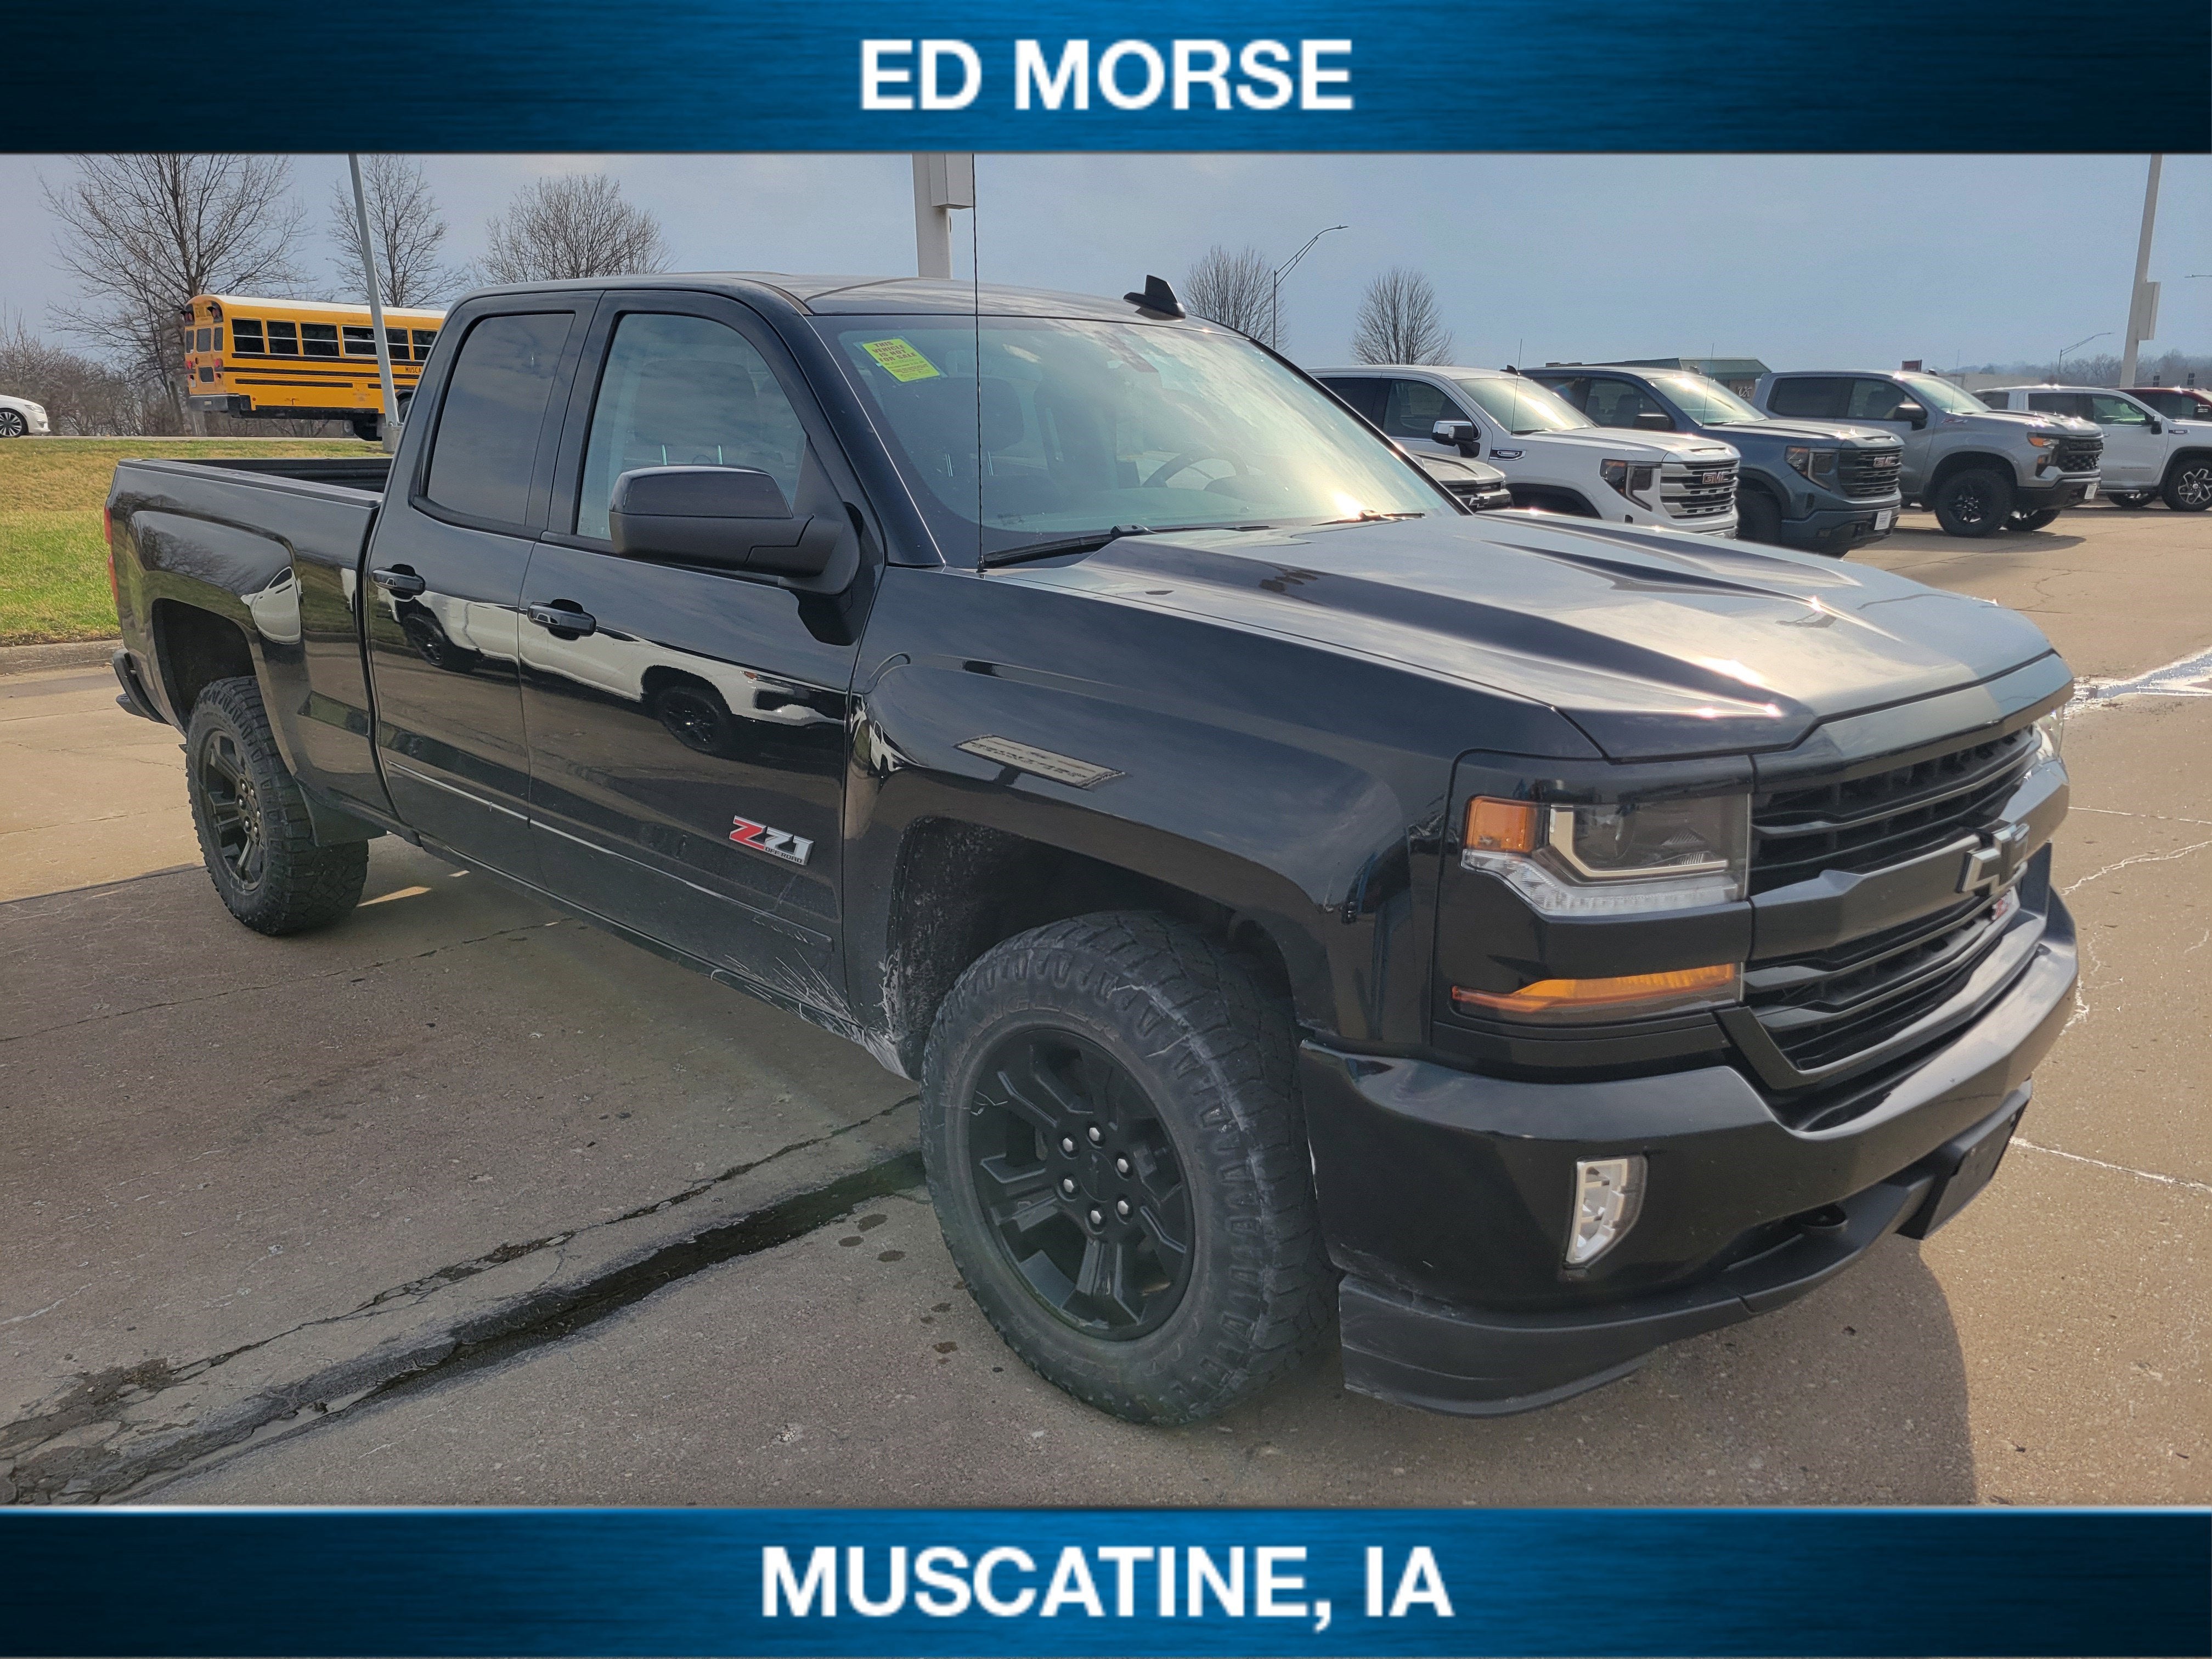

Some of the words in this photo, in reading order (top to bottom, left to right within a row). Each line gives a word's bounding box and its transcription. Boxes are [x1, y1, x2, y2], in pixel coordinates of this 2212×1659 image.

[872, 345, 905, 353] VEHICLE
[1702, 471, 1730, 484] GMC
[729, 815, 814, 865] Z71
[765, 847, 780, 856] OFF
[781, 852, 803, 864] ROAD
